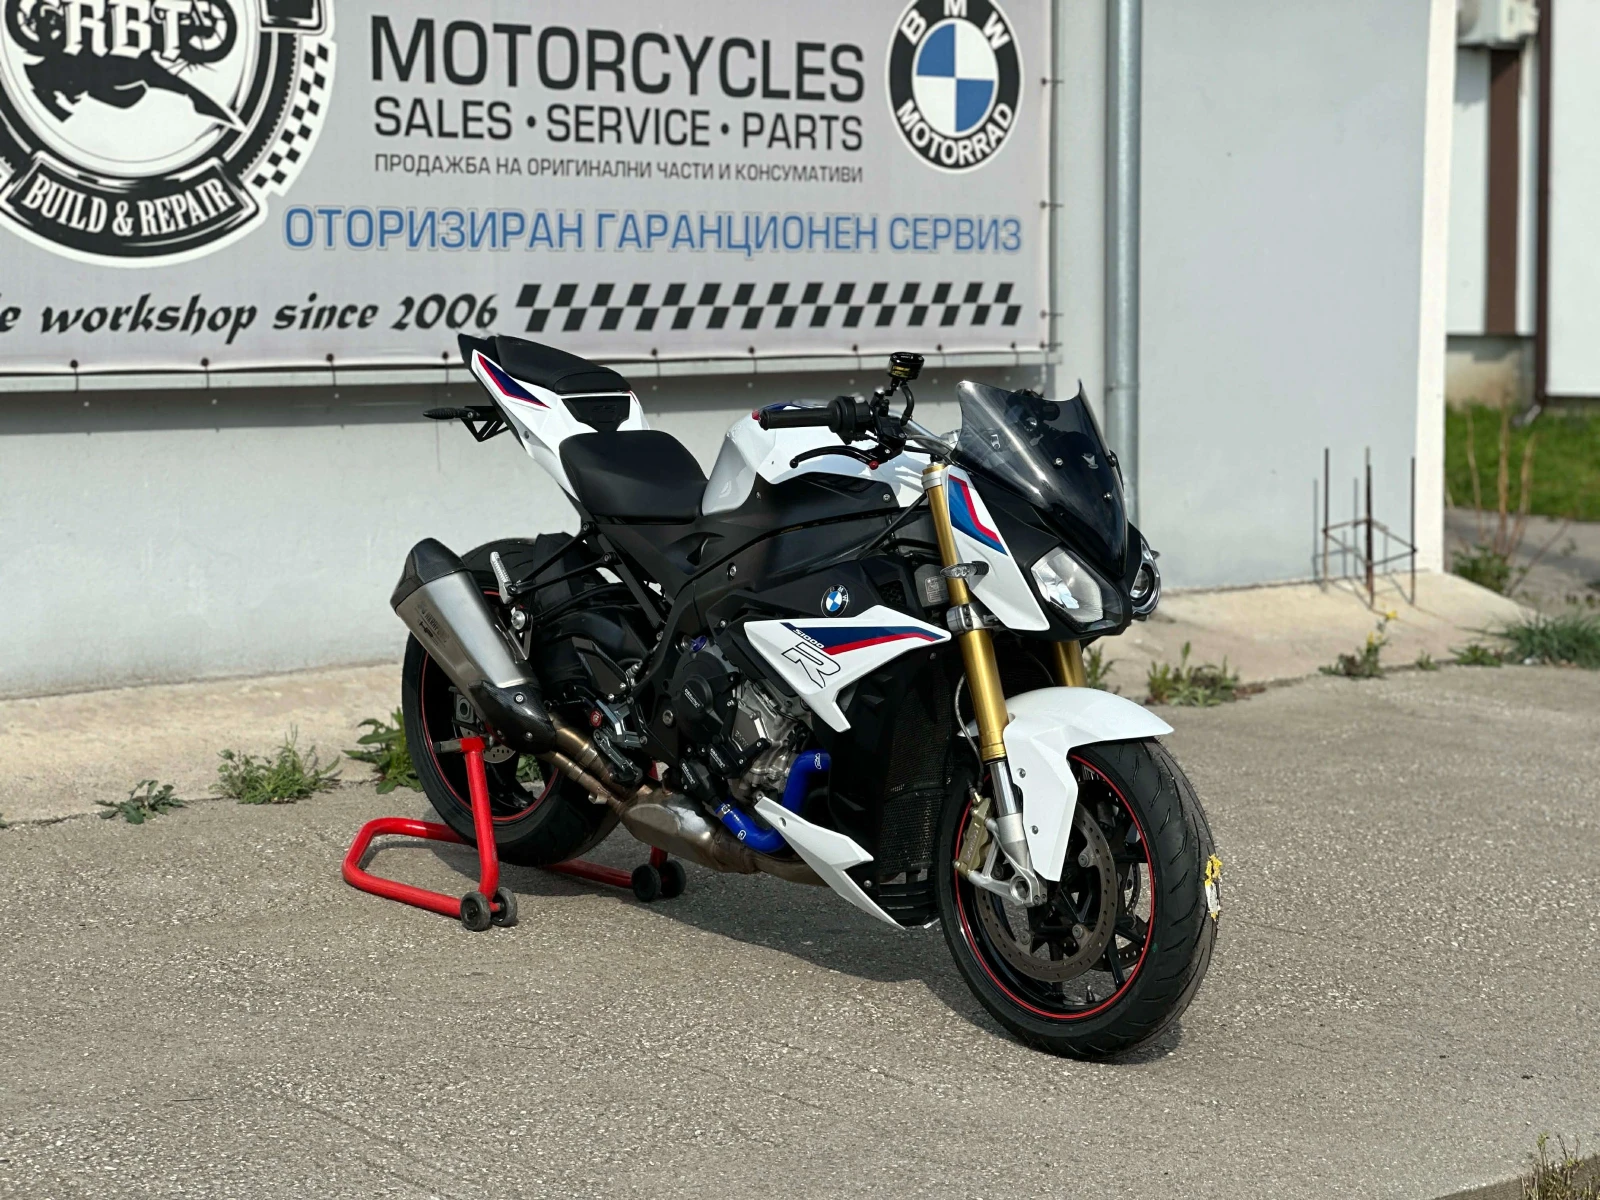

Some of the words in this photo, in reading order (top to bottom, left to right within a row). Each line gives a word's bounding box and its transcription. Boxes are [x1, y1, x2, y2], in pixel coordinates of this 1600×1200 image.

[900, 0, 1010, 50] BMW
[371, 14, 865, 103] MOTORCYCLES
[374, 95, 513, 141] SALES
[546, 103, 710, 147] SERVICE
[743, 111, 863, 152] PARTS
[897, 98, 1013, 166] MOTORRAD
[375, 153, 491, 177] ПРОДАЖБА
[496, 157, 523, 175] НА
[527, 157, 652, 178] ОРИГИНАЛНИ
[656, 162, 714, 180] ЧАСТИ
[718, 163, 731, 180] И
[735, 163, 863, 183] КОНСУМАТИВИ
[22, 172, 108, 233] BUILD
[112, 200, 135, 236] &
[137, 177, 235, 236] REPAIR
[285, 207, 583, 249] ОТОРИЗИРАН
[597, 212, 877, 256] ГАРАНЦИОНЕН
[889, 216, 1020, 251] СЕРВИЗ
[0, 293, 22, 332] e
[40, 293, 258, 346] workshop
[272, 292, 380, 330] since
[390, 293, 498, 331] 2006
[793, 628, 825, 649] S1000
[781, 641, 841, 689] R
